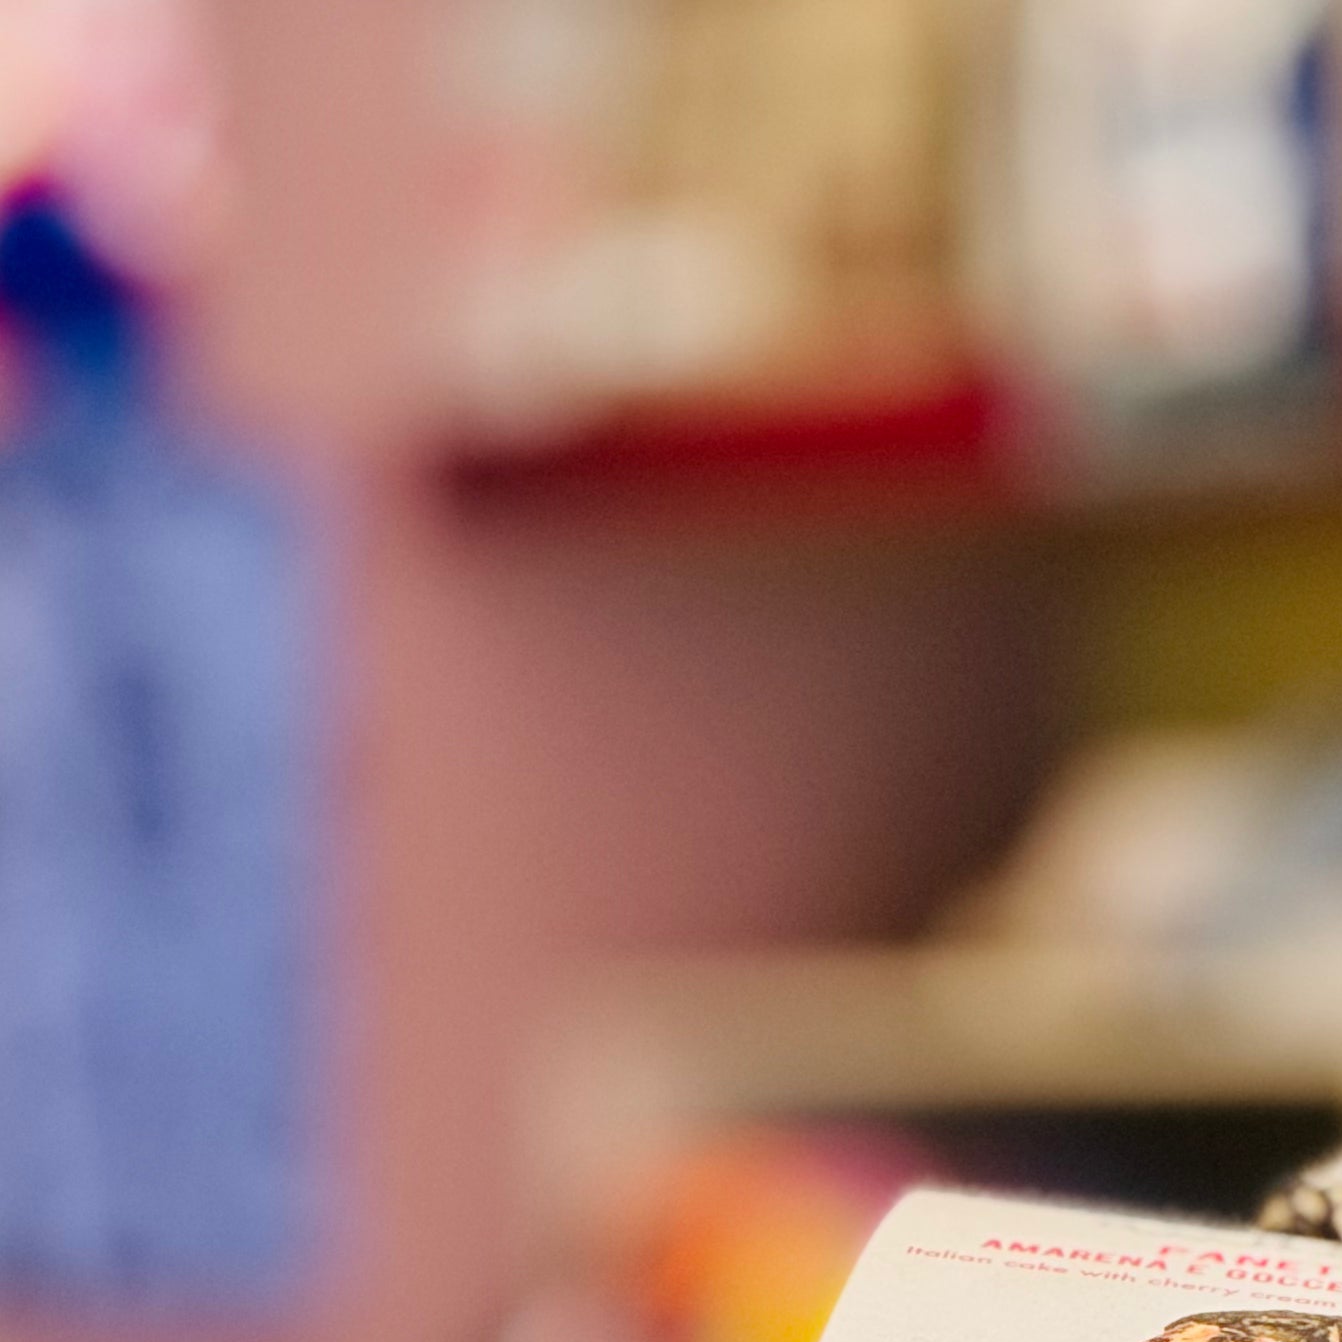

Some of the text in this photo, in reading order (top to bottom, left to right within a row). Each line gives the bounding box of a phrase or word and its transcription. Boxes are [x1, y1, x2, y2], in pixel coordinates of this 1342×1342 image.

[907, 1246, 992, 1265] Italian
[1003, 1261, 1069, 1273] cake
[1080, 1267, 1136, 1283] with
[1148, 1277, 1241, 1298] cherry
[1250, 1291, 1336, 1308] cream
[981, 1239, 1168, 1271] AMARENA
[1187, 1264, 1204, 1276] E
